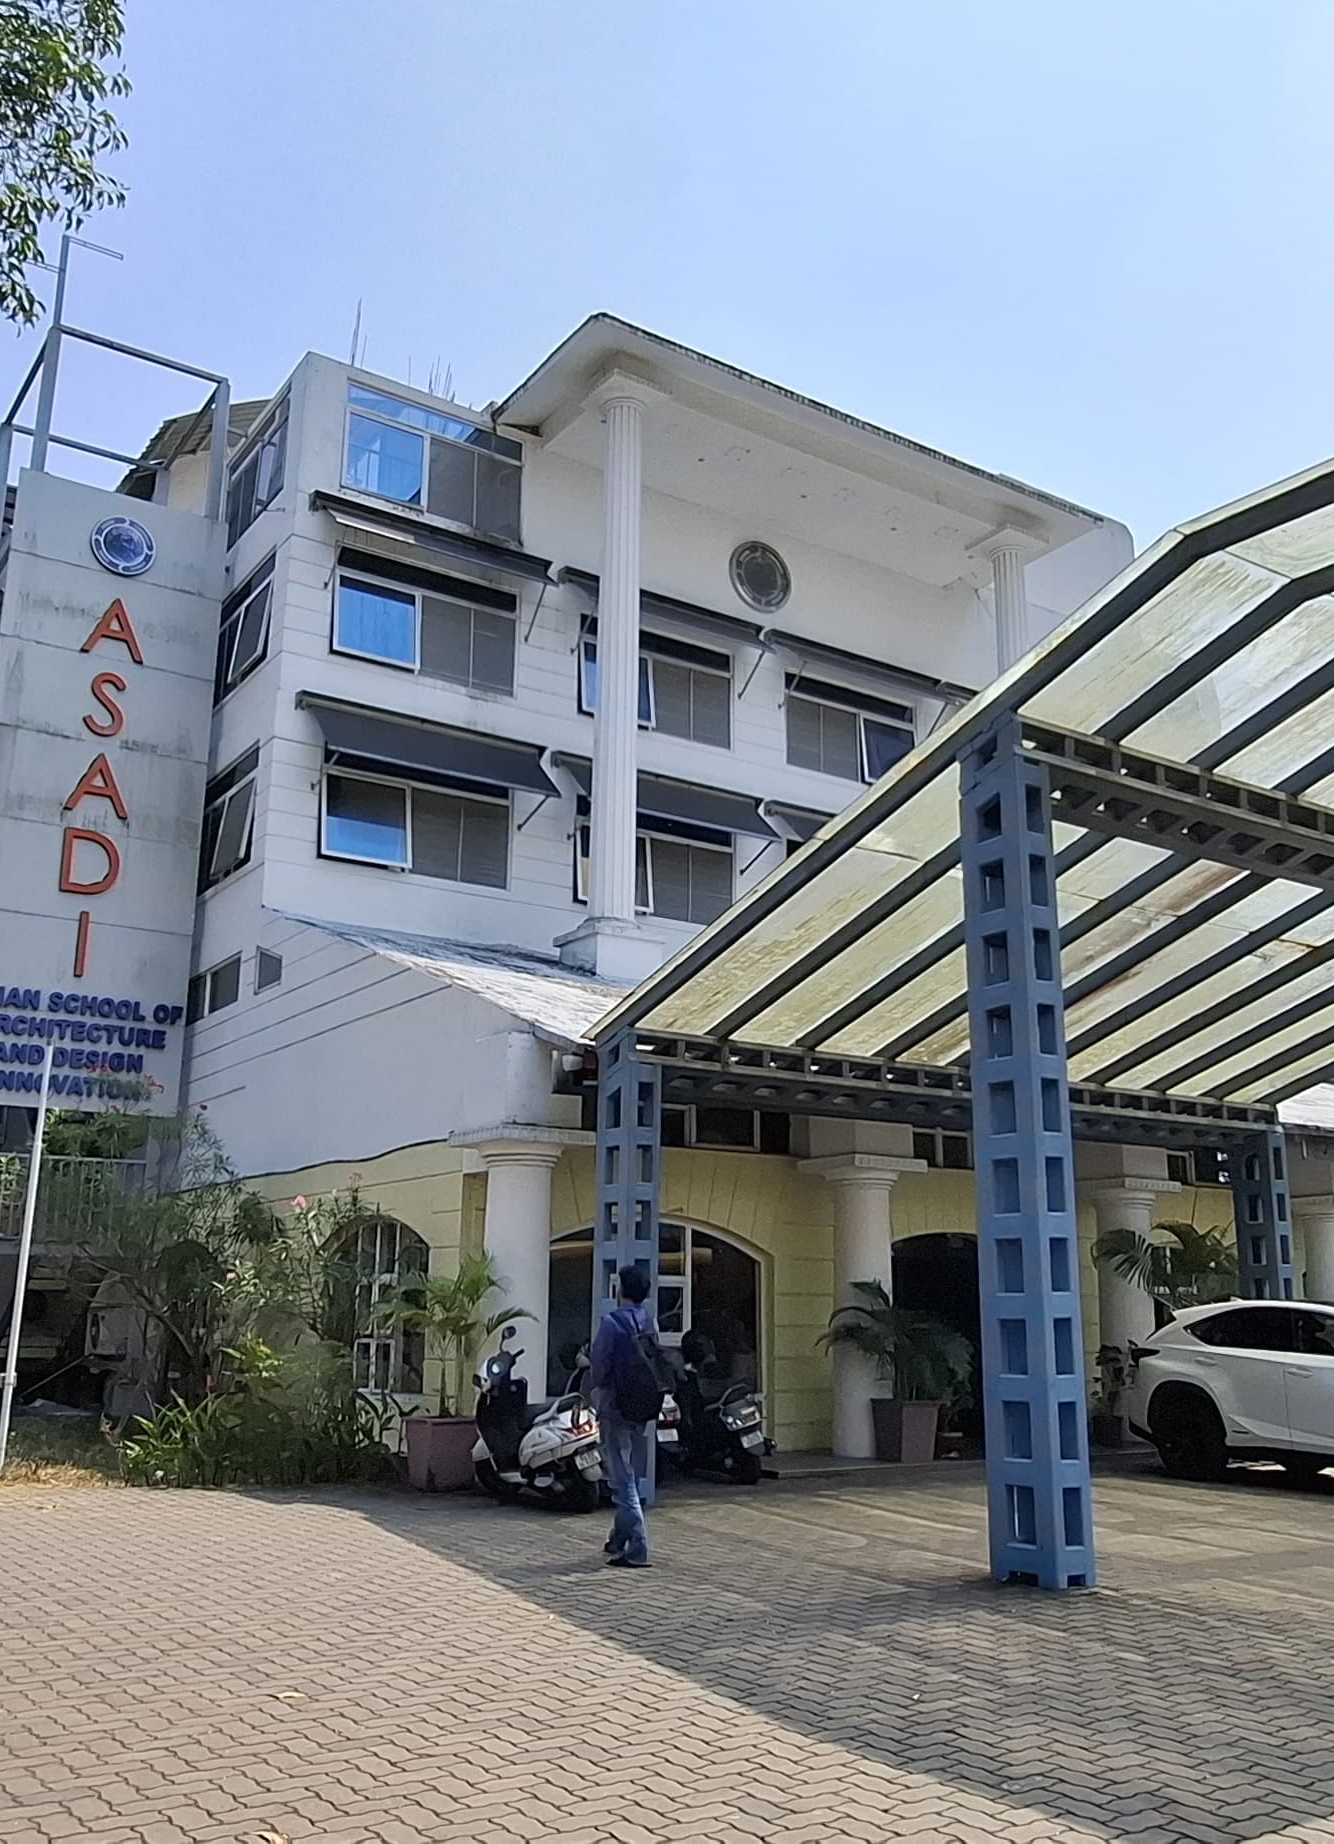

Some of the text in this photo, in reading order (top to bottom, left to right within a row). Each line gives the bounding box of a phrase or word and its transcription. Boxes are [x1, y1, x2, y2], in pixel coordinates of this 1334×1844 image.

[58, 597, 145, 978] ASADI
[47, 991, 146, 1022] SCHOOL
[153, 1003, 184, 1025] OF
[52, 1046, 144, 1074] DESIGN
